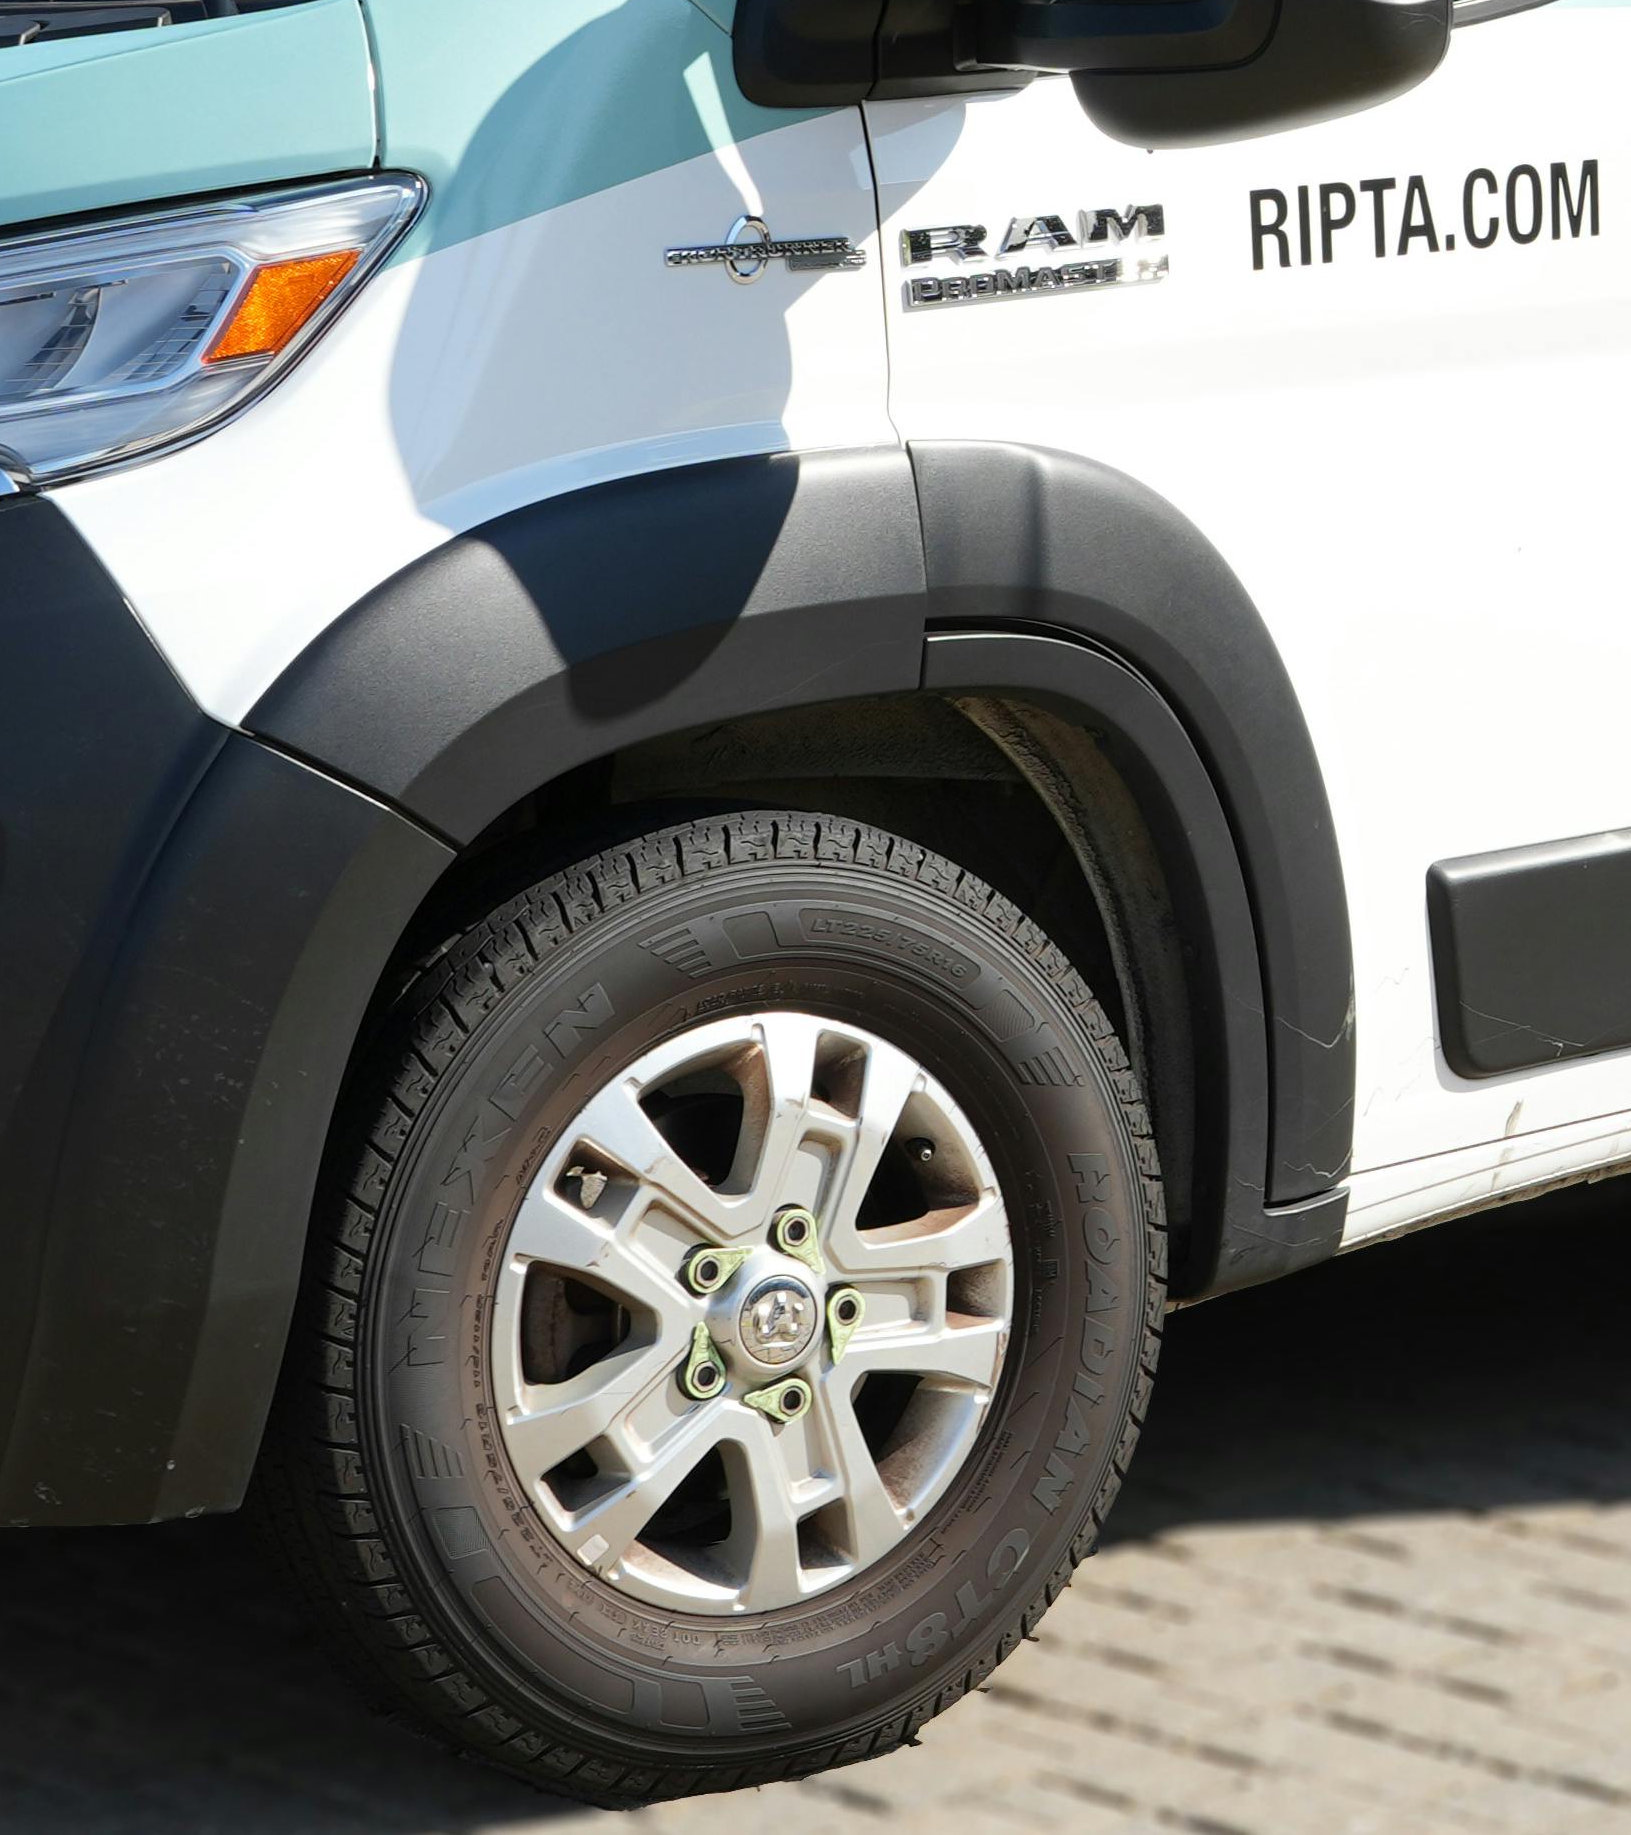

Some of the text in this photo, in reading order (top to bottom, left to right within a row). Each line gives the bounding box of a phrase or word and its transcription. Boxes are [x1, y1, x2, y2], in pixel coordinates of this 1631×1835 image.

[899, 203, 1165, 271] RAM
[1249, 159, 1599, 270] RIPTA.COM
[407, 981, 617, 1368] NEXEN
[1031, 1151, 1121, 1518] ROADIAN
